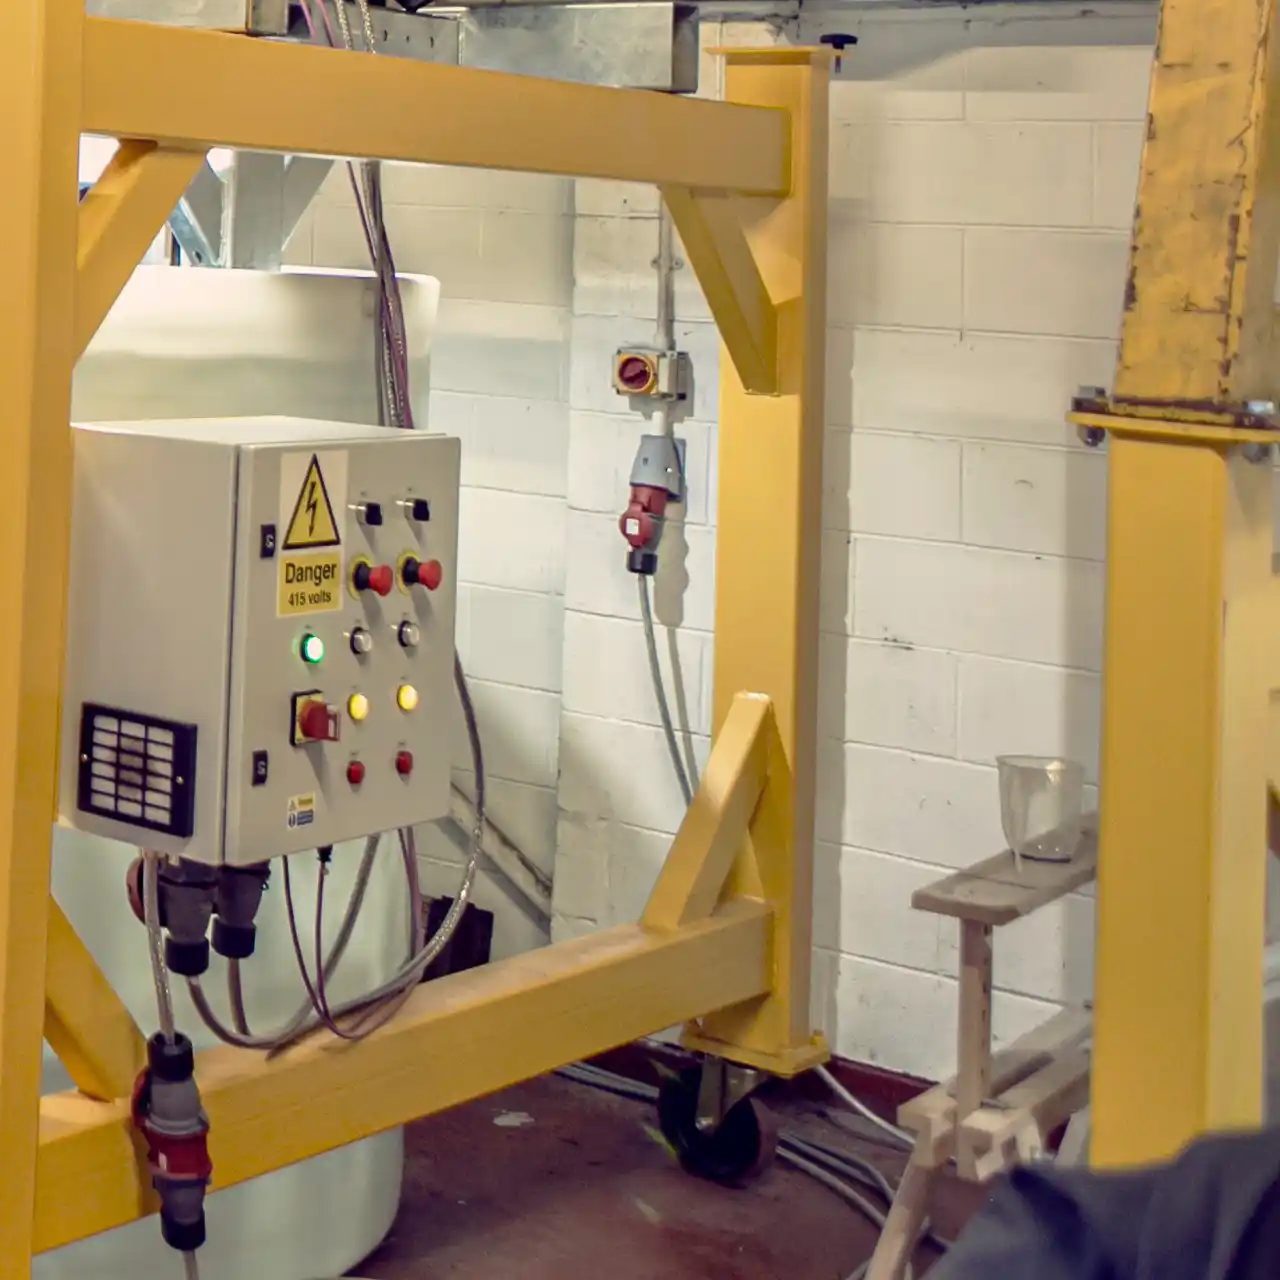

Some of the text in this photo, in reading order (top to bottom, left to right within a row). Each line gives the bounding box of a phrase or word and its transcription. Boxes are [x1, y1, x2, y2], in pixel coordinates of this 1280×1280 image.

[285, 562, 337, 586] Danger
[288, 589, 332, 606] 415 volts
